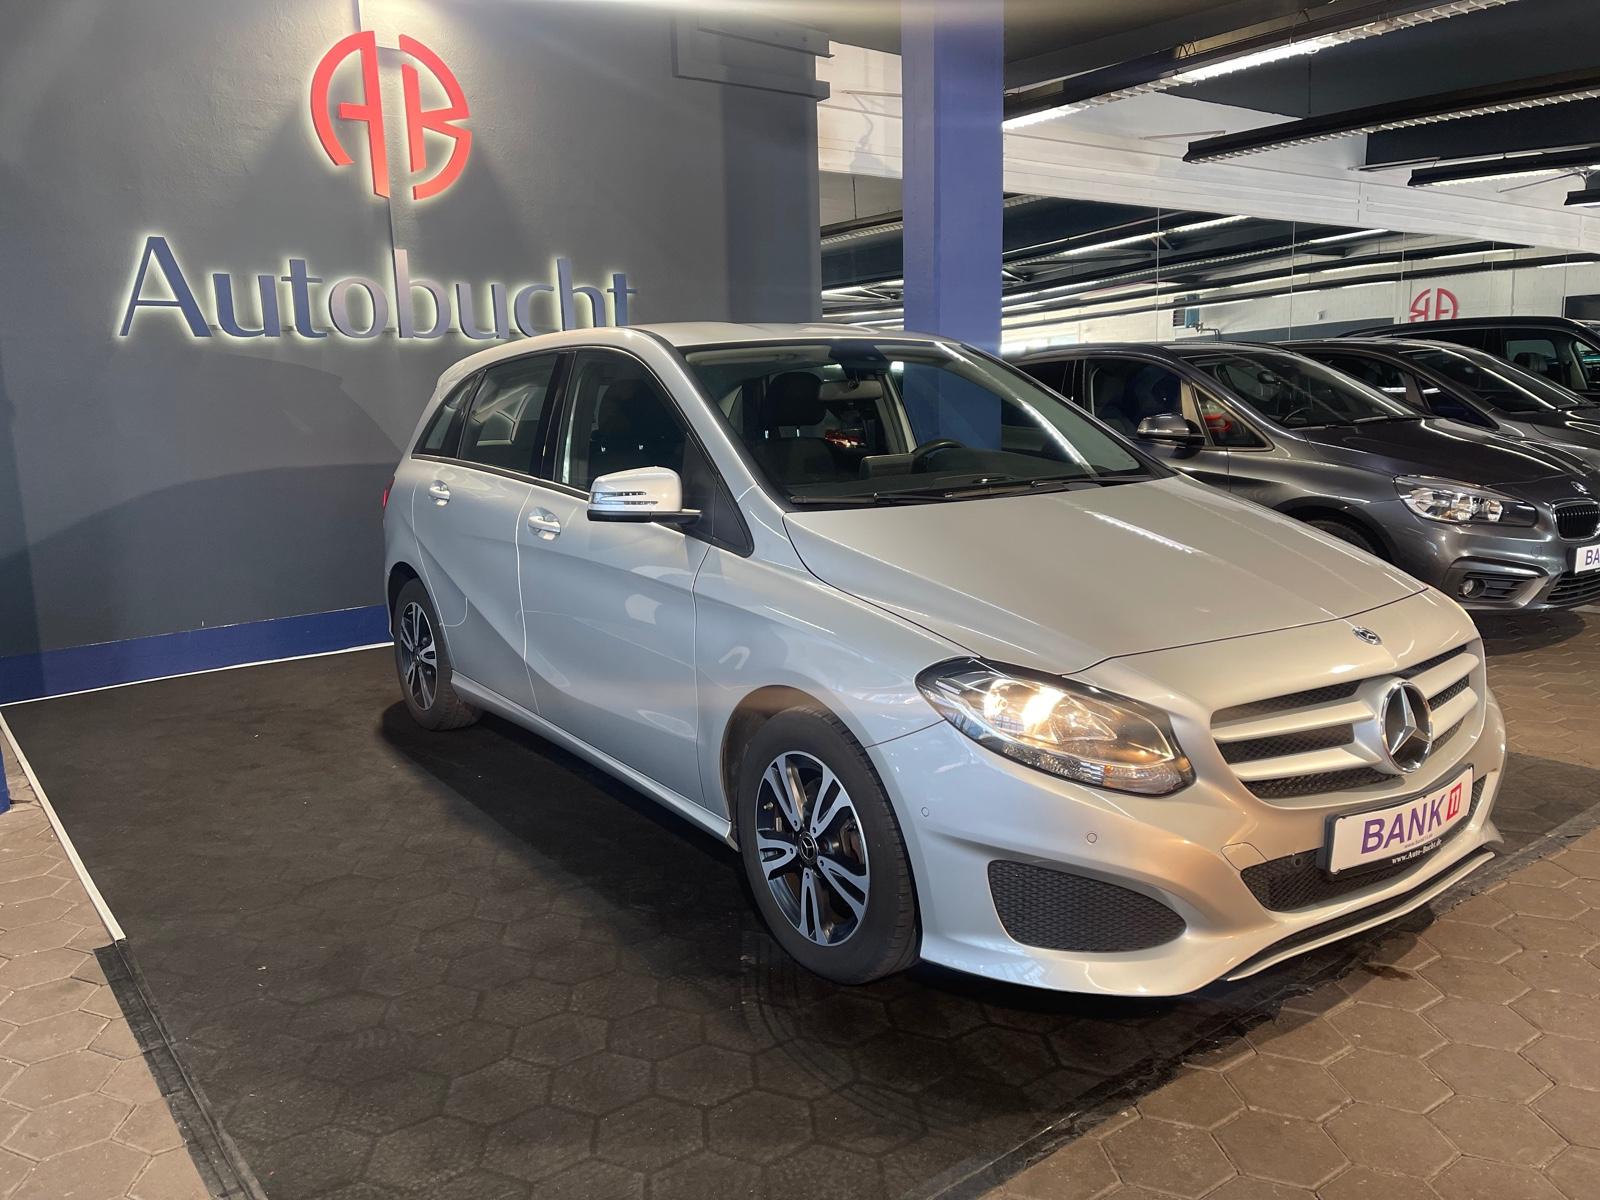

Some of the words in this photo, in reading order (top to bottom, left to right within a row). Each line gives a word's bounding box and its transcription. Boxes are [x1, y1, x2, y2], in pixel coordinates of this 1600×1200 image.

[311, 31, 472, 200] AB
[119, 236, 637, 341] Autobucht
[1361, 794, 1446, 854] BANK
